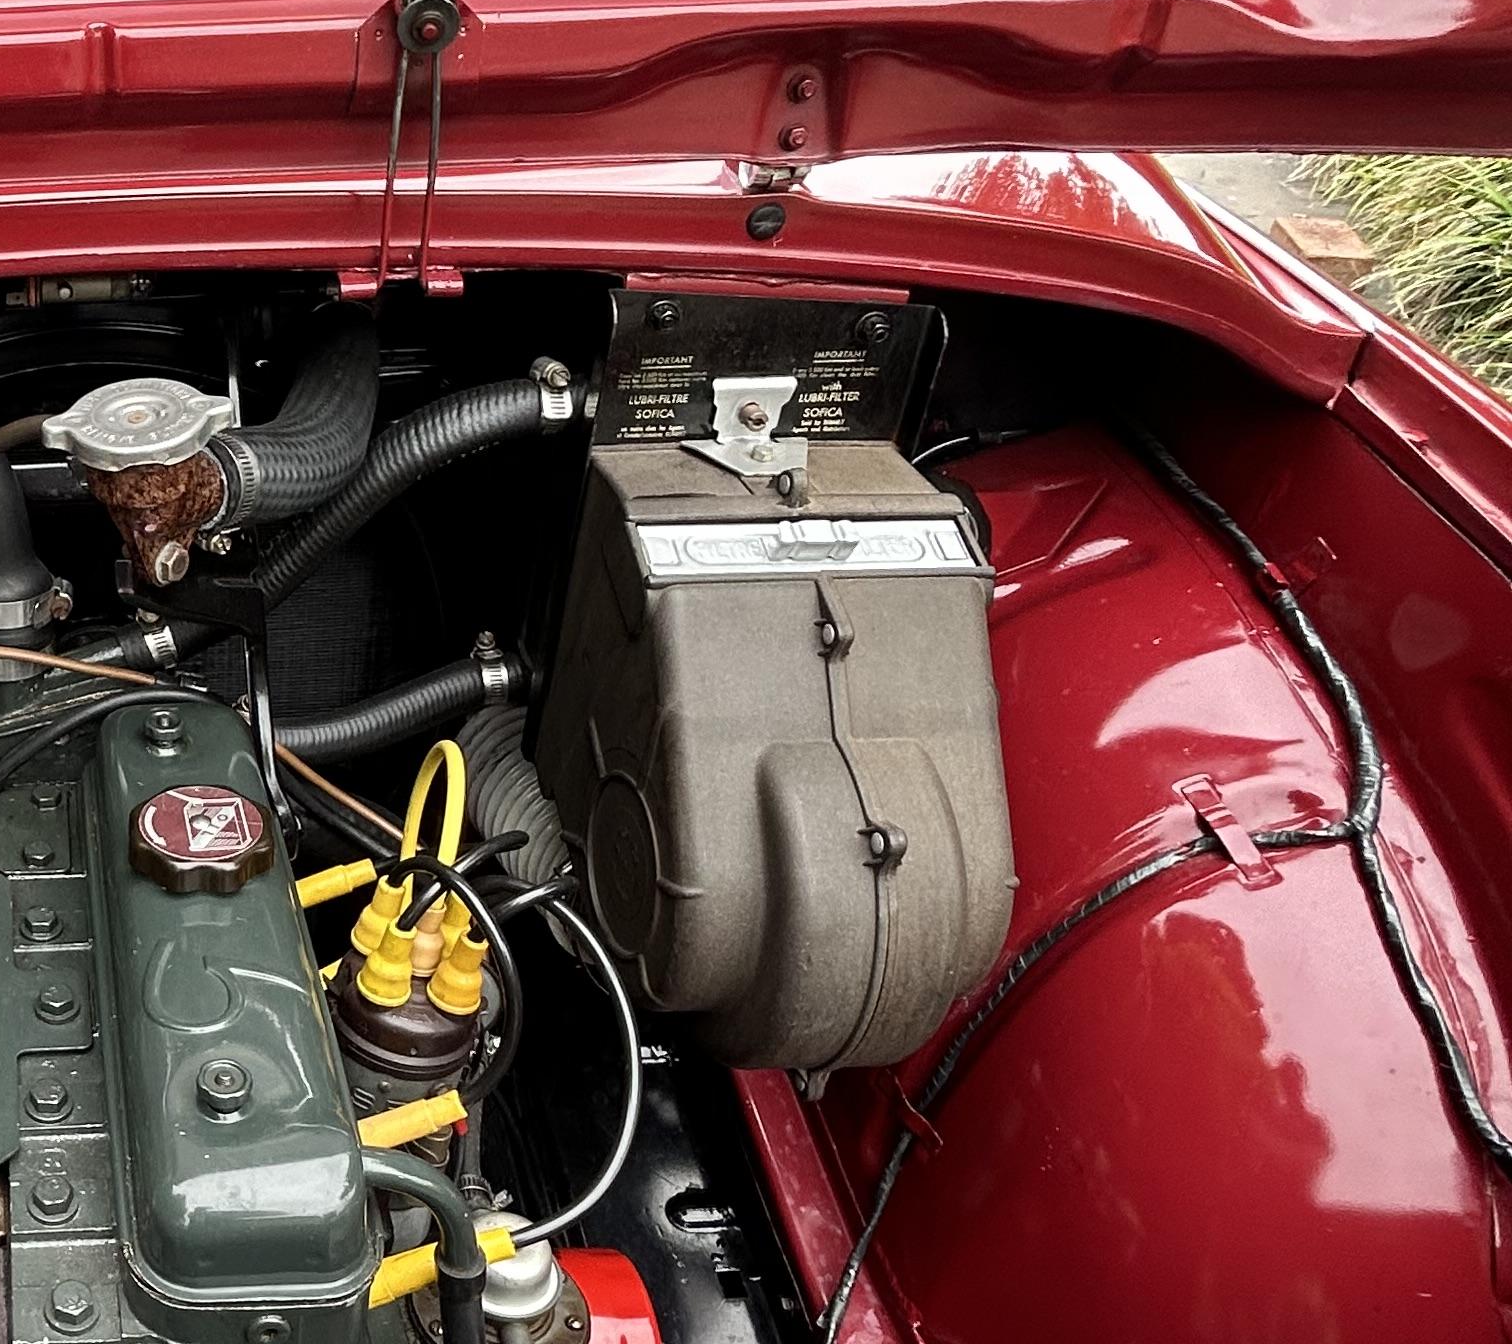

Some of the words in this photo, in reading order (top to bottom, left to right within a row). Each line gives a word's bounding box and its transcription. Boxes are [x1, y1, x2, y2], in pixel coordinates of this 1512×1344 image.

[814, 350, 867, 358] IMPORTANT
[641, 356, 693, 365] IMPORTANT
[635, 409, 675, 419] SOFICA
[802, 407, 842, 418] SOFICA
